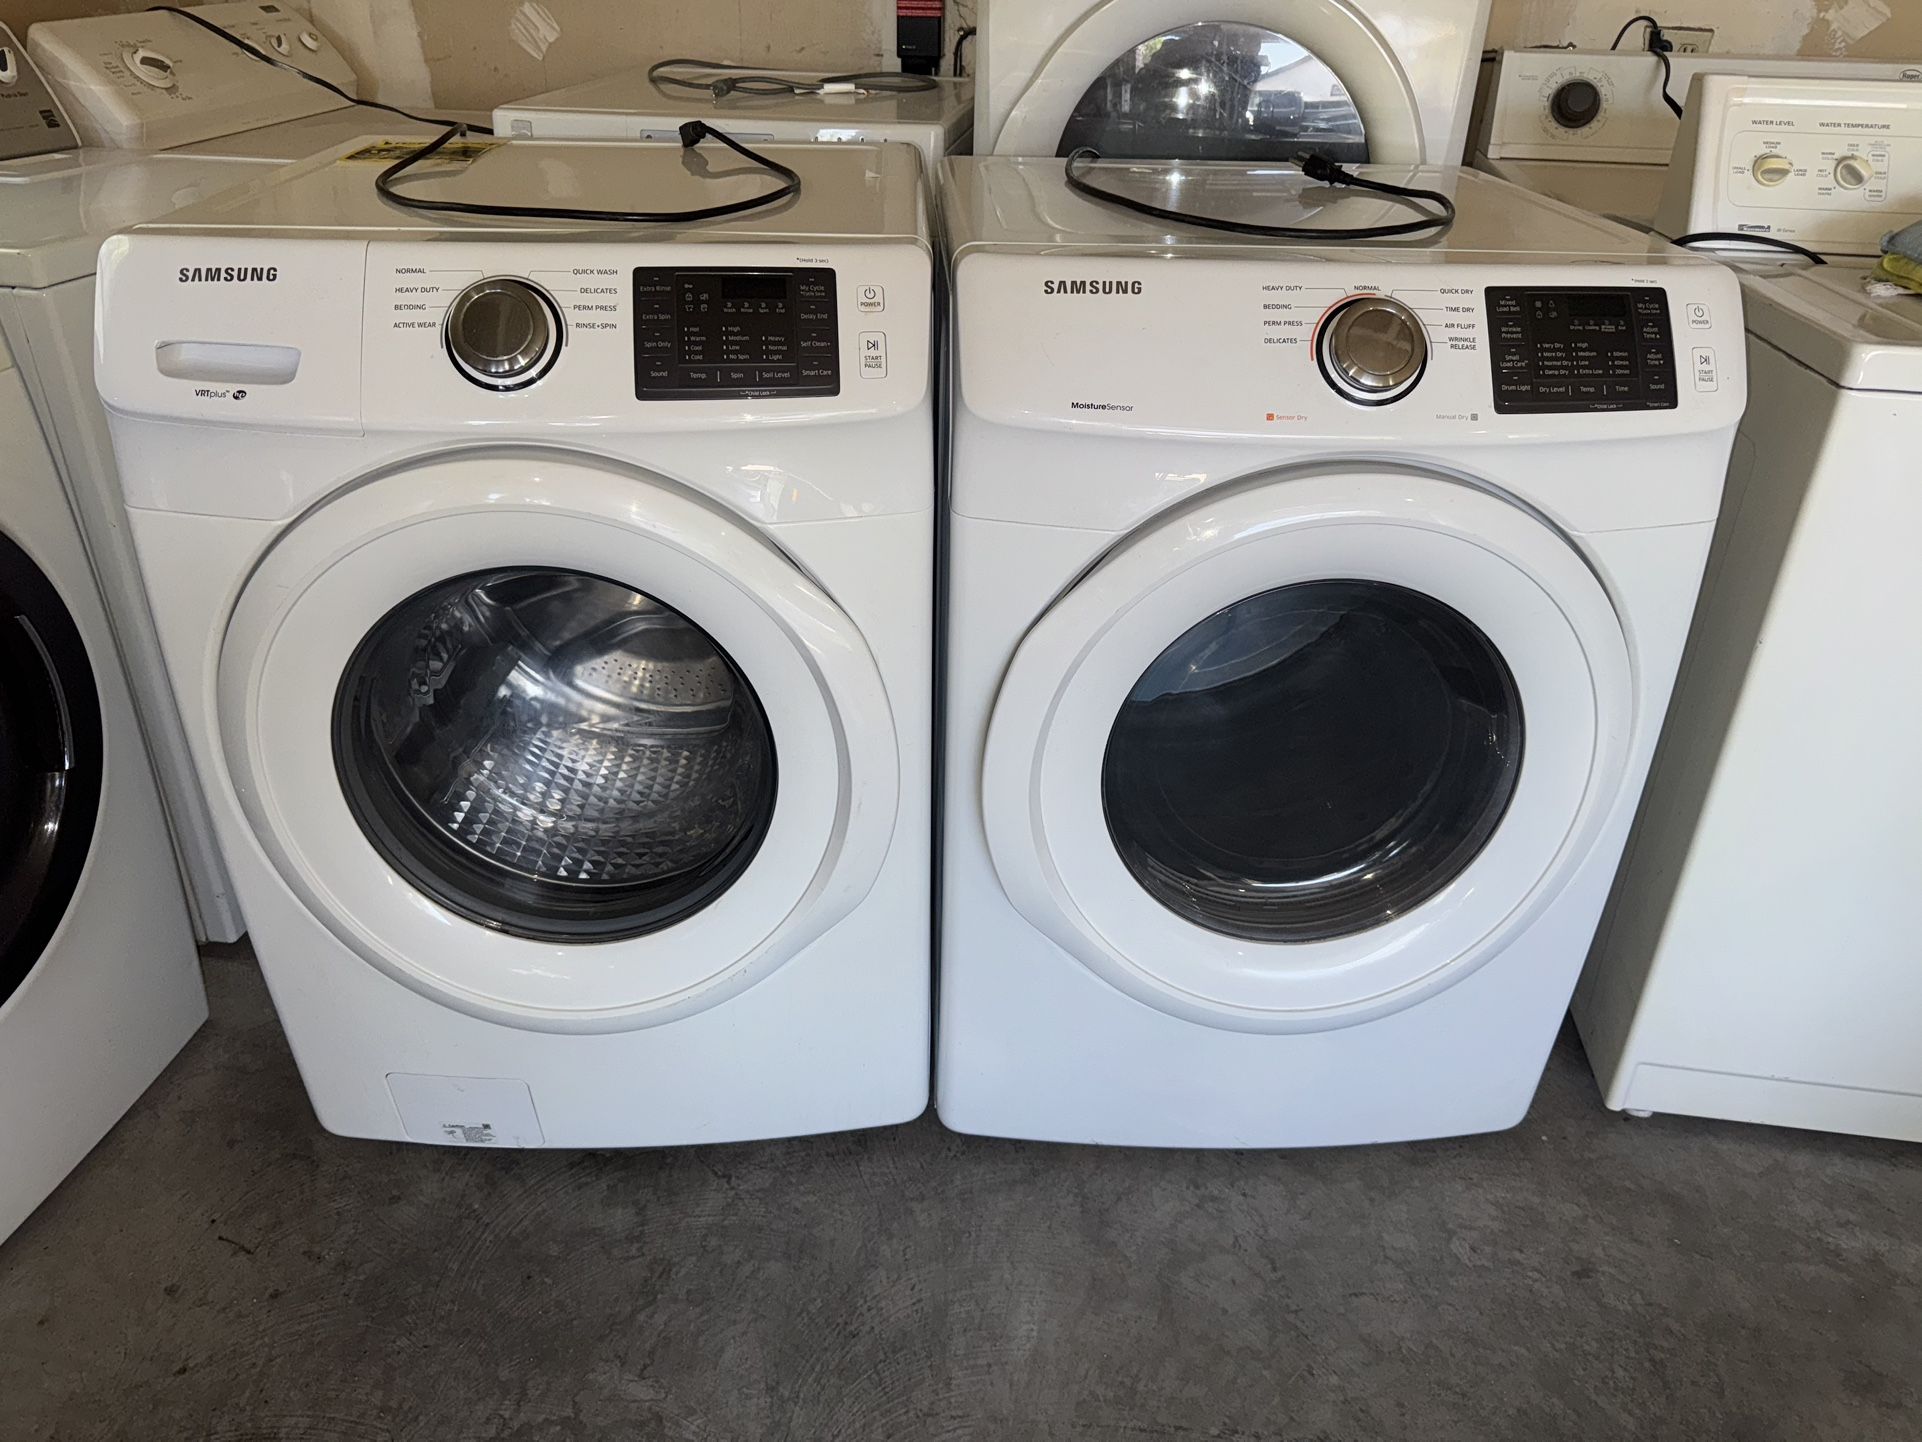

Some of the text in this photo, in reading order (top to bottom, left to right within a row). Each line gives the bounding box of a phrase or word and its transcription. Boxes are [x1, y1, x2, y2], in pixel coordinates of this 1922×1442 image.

[179, 267, 278, 283] SAMSUNG
[395, 267, 427, 275] NORMAL
[573, 268, 596, 276] QUICK
[1044, 280, 1142, 295] SAMSUNG
[573, 304, 594, 312] PERM
[393, 321, 437, 329] ACTIVE WEAR
[1448, 336, 1477, 344] WRINKLE
[1450, 343, 1477, 351] RELEASE
[1071, 402, 1134, 412] MoistureSensor
[1294, 414, 1308, 422] Dry
[1457, 414, 1469, 422] Dry
